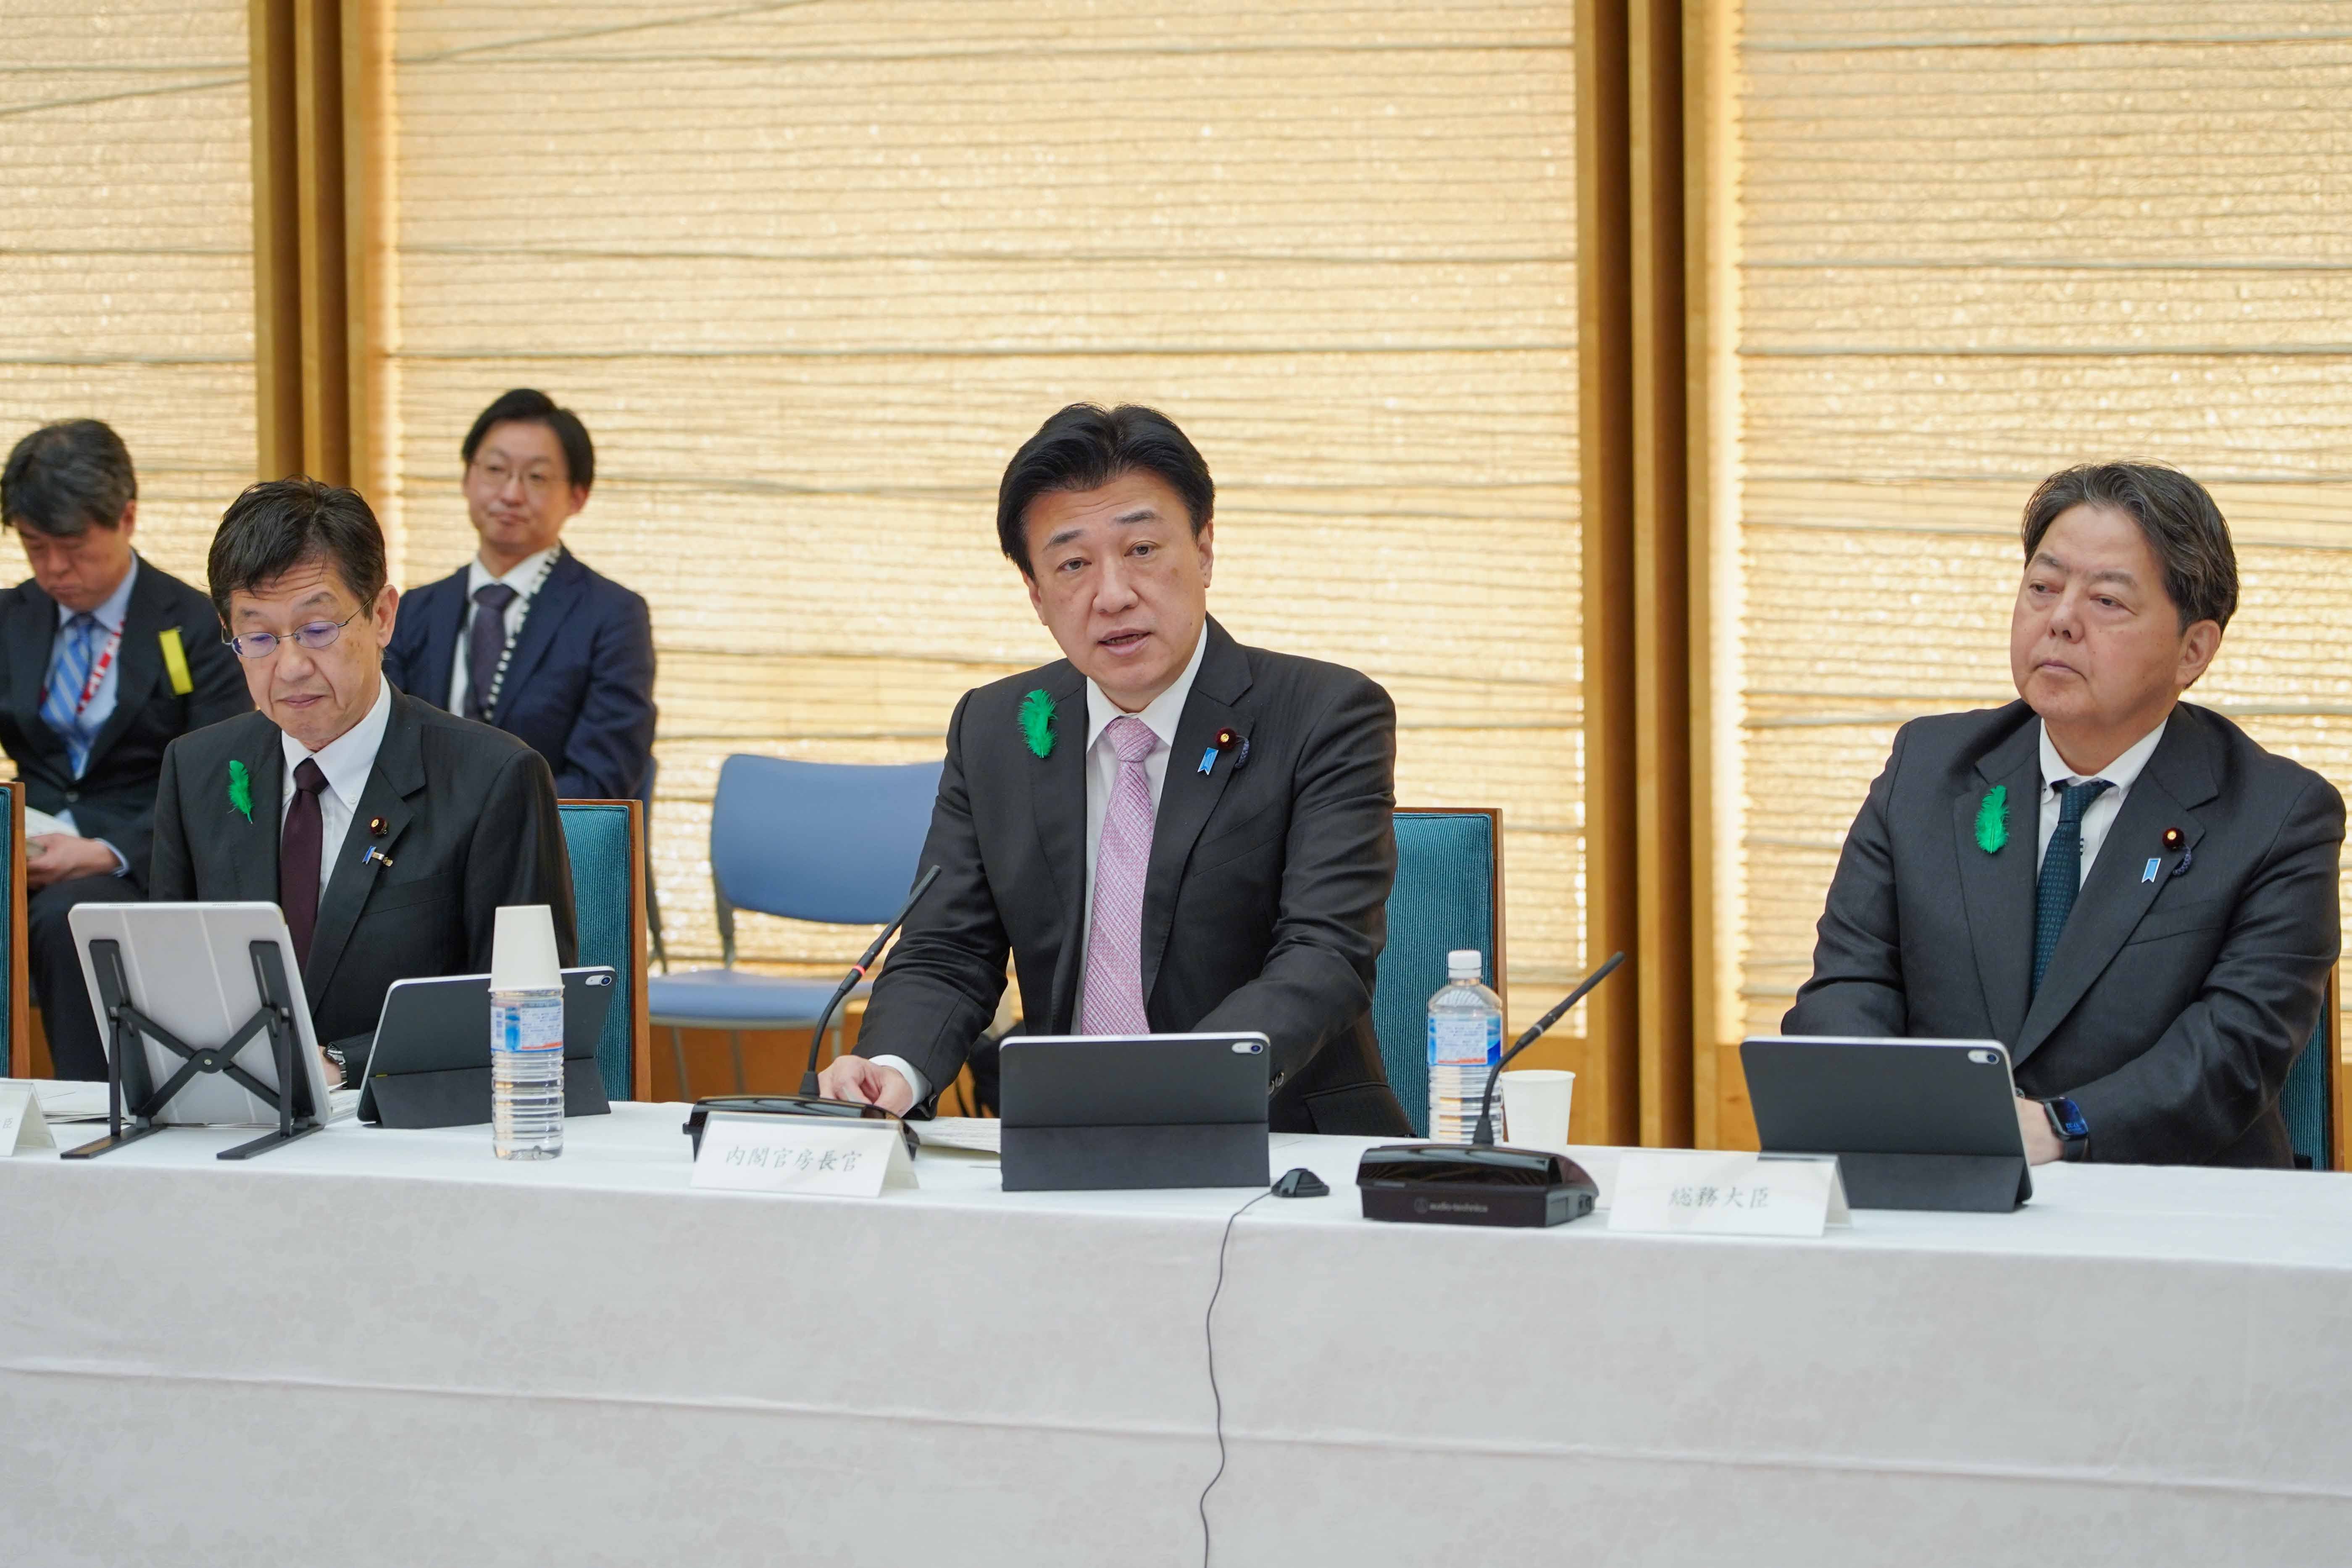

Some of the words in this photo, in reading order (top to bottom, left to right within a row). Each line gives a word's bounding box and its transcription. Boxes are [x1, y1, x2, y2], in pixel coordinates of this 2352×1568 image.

[725, 1145, 863, 1172] 内閣官房長官
[1669, 1186, 1769, 1209] 総務大臣
